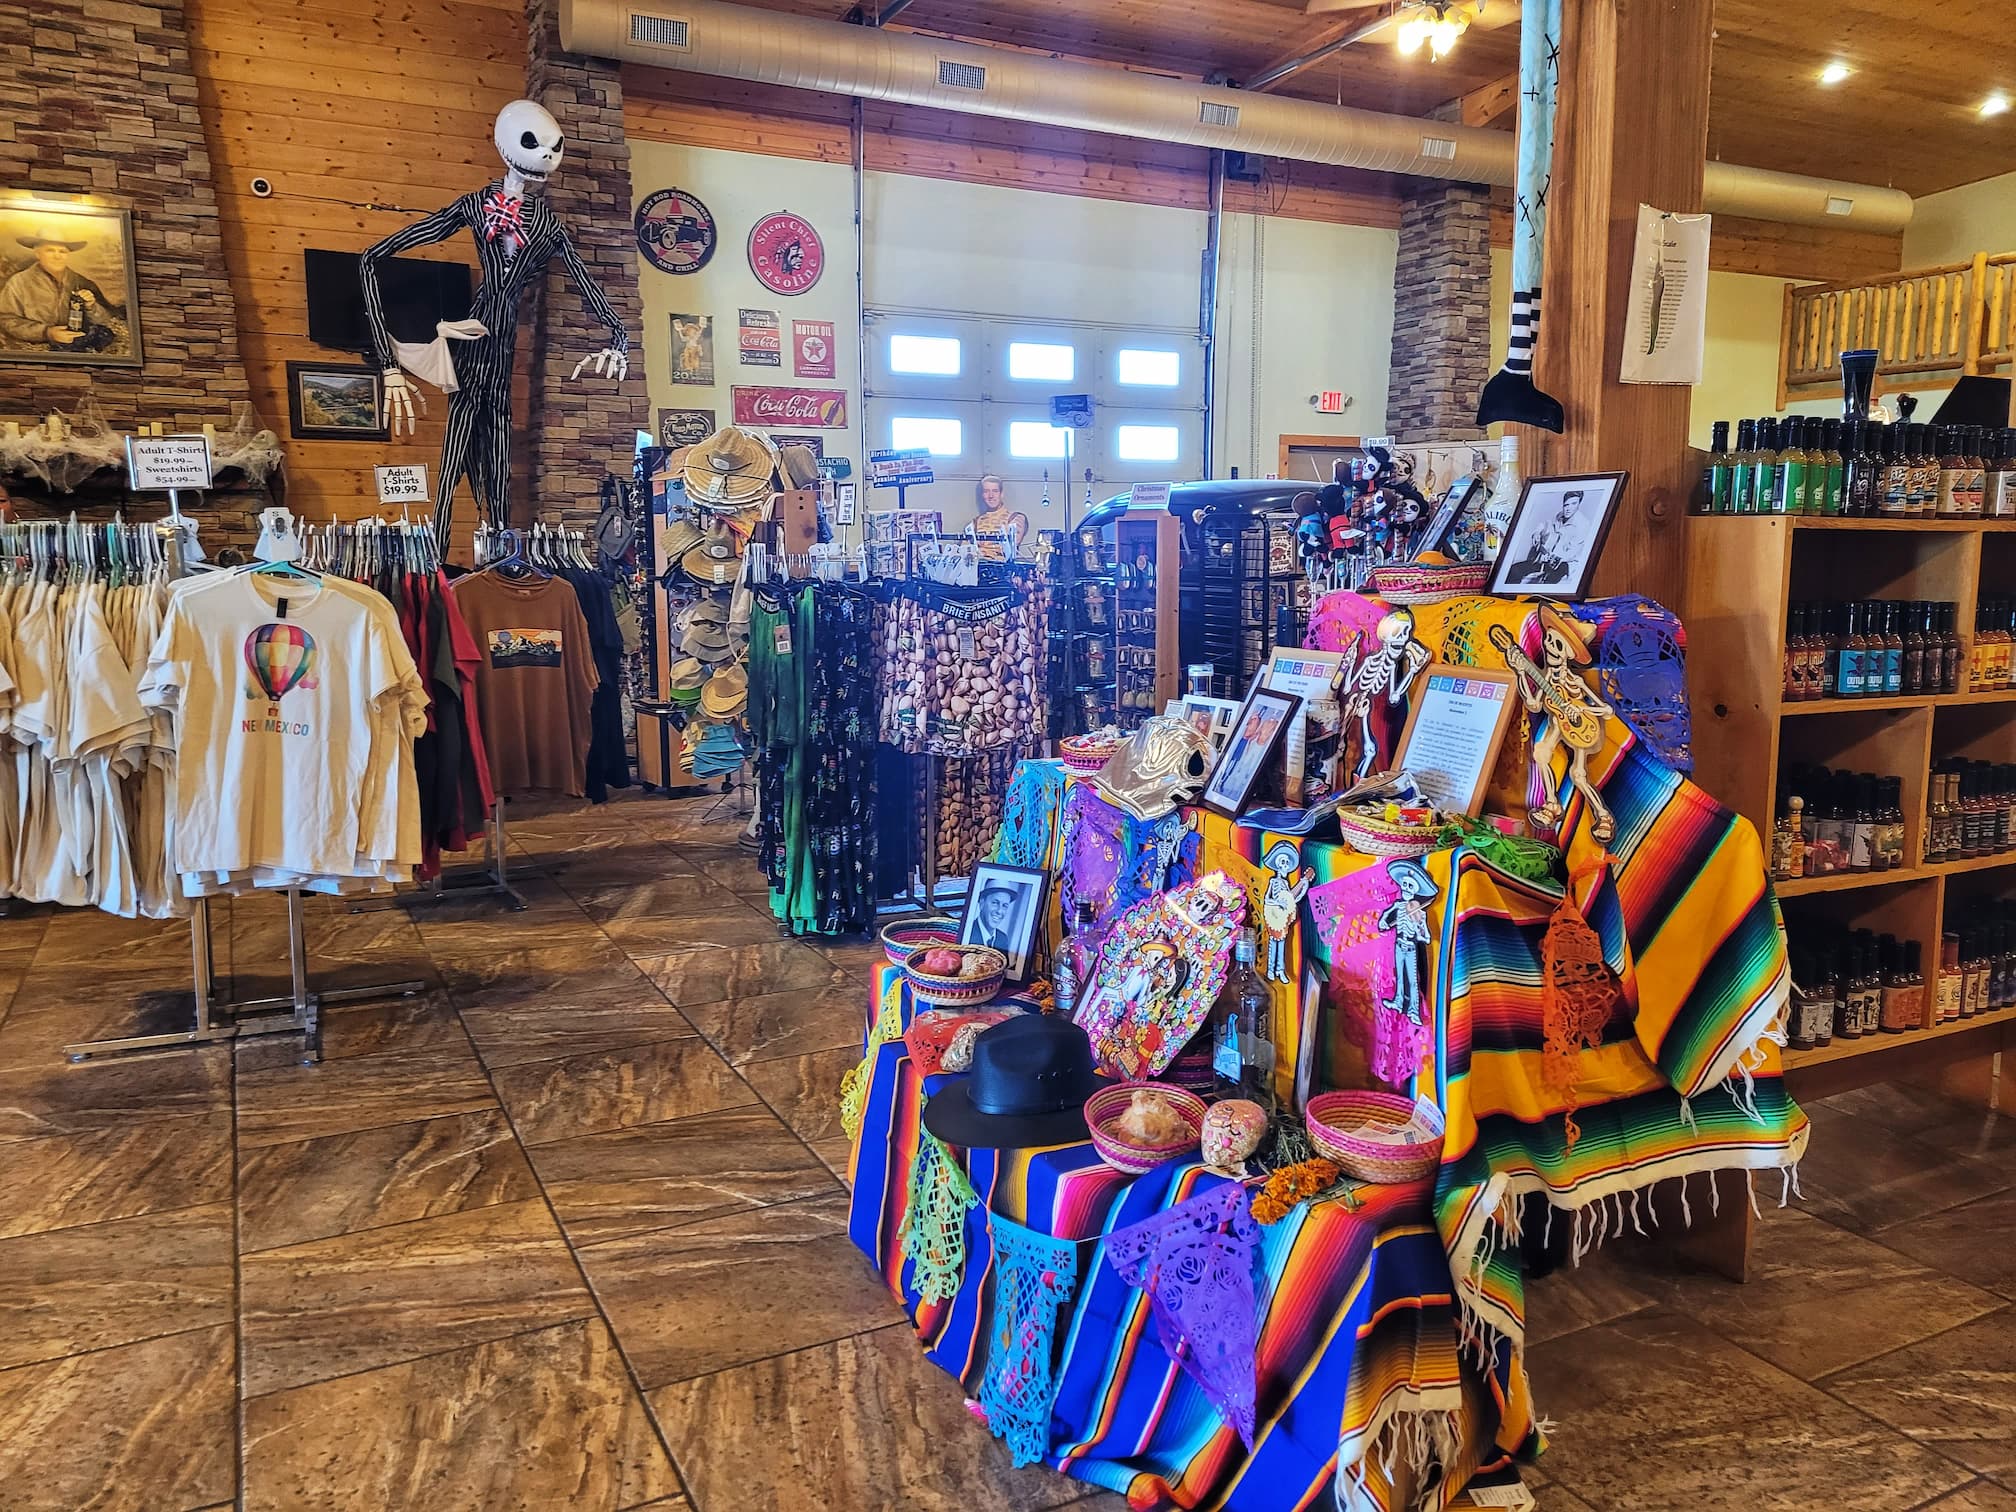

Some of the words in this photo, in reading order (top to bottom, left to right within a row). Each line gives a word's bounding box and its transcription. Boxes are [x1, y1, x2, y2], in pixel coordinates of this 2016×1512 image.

[641, 200, 654, 215] HOT
[653, 192, 670, 202] ROD
[671, 192, 711, 222] ROADHOUSE
[756, 221, 786, 245] Silent
[789, 221, 816, 247] Chief
[657, 260, 674, 270] AND
[675, 262, 699, 272] GRILL
[758, 255, 817, 288] Gasoline
[795, 324, 820, 336] MOTOR
[821, 325, 833, 337] OIL
[673, 370, 689, 380] 20
[1322, 391, 1341, 411] EXIT
[138, 446, 165, 454] Adult
[166, 446, 205, 454] T-Shirts
[145, 465, 203, 473] Sweatshirts
[388, 467, 413, 477] Adult
[382, 476, 420, 485] T-Shirts
[384, 485, 418, 495] $19.99
[942, 602, 972, 620] BRIEF
[265, 719, 310, 737] MEXICO
